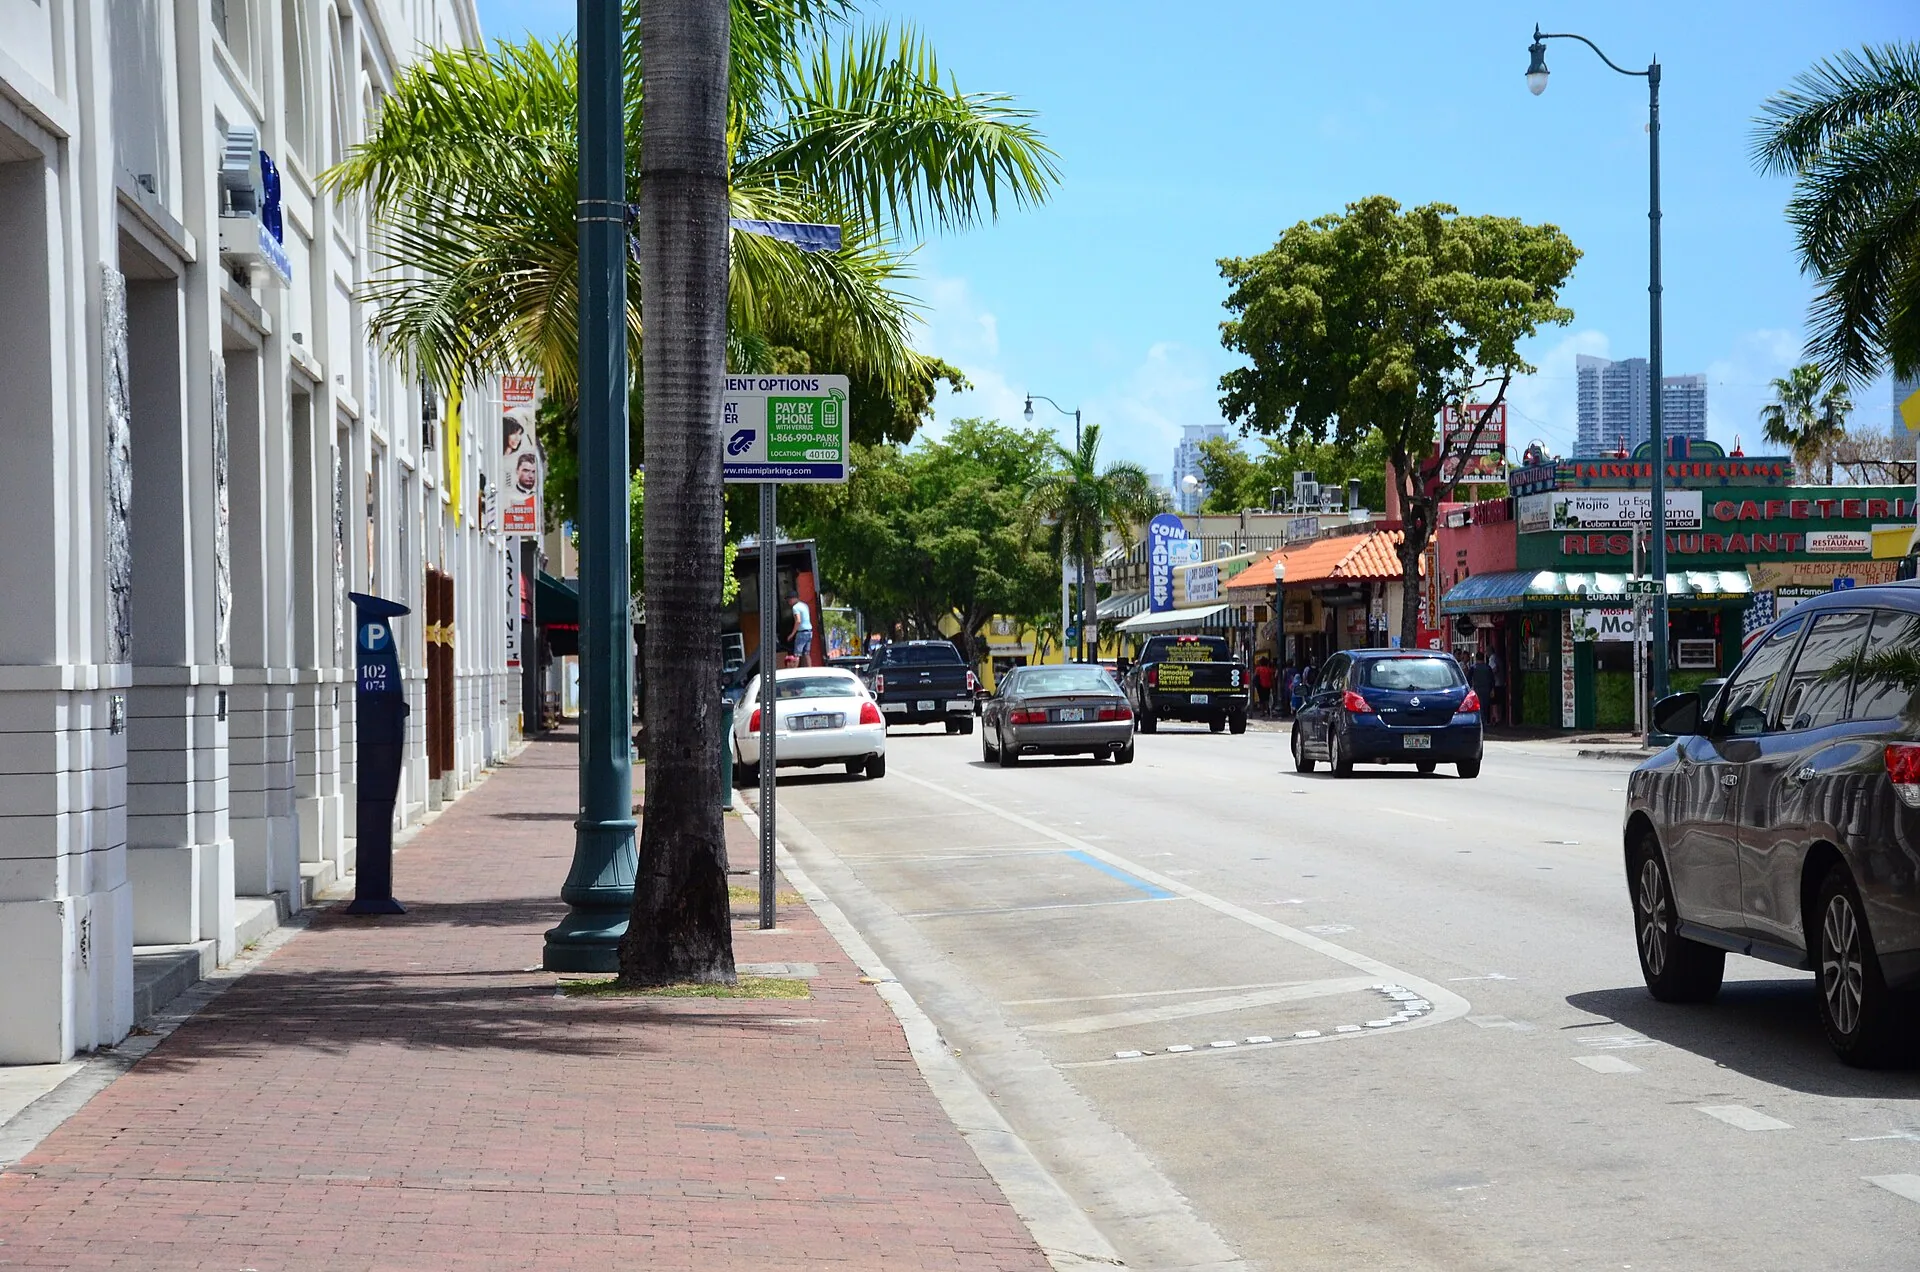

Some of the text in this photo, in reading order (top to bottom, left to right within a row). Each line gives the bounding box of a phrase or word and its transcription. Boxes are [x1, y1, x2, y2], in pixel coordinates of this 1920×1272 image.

[758, 379, 819, 391] OPTIONS
[775, 402, 814, 414] PAY BY
[775, 414, 814, 425] PHONE
[770, 433, 840, 443] 1-866-990-PARK
[809, 452, 836, 460] 40102
[1576, 502, 1609, 511] Mojito
[1619, 497, 1630, 506] La
[1619, 507, 1635, 519] de
[1151, 523, 1185, 539] COIN
[1152, 535, 1168, 606] LAUNDRY
[1794, 564, 1812, 574] THE
[1812, 563, 1836, 574] MOST
[1840, 563, 1876, 575] FAMOUS
[1866, 574, 1880, 584] THE
[1640, 582, 1652, 592] 14
[1778, 587, 1799, 597] Most
[368, 623, 385, 649] P
[361, 665, 386, 678] 102
[365, 681, 385, 690] 074
